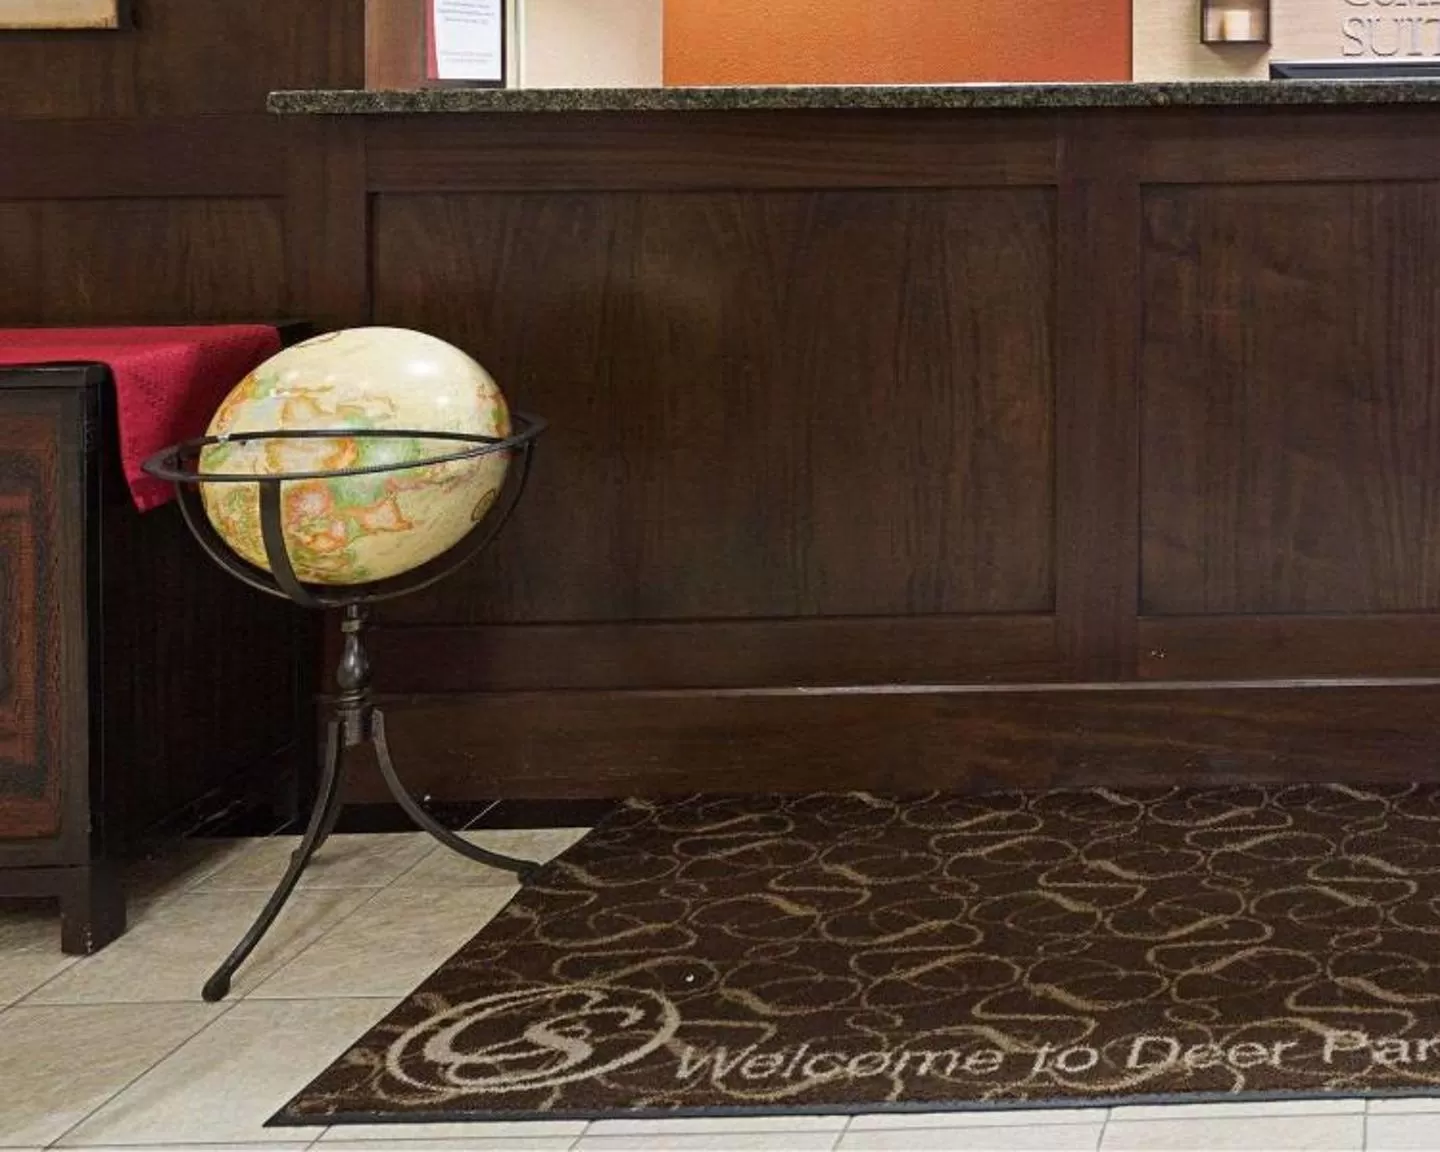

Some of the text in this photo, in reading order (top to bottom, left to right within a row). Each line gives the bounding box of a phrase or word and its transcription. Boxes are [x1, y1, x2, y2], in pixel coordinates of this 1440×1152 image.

[674, 1041, 1003, 1080] Welcome
[1032, 1039, 1099, 1074] to
[1126, 1035, 1298, 1070] Deer
